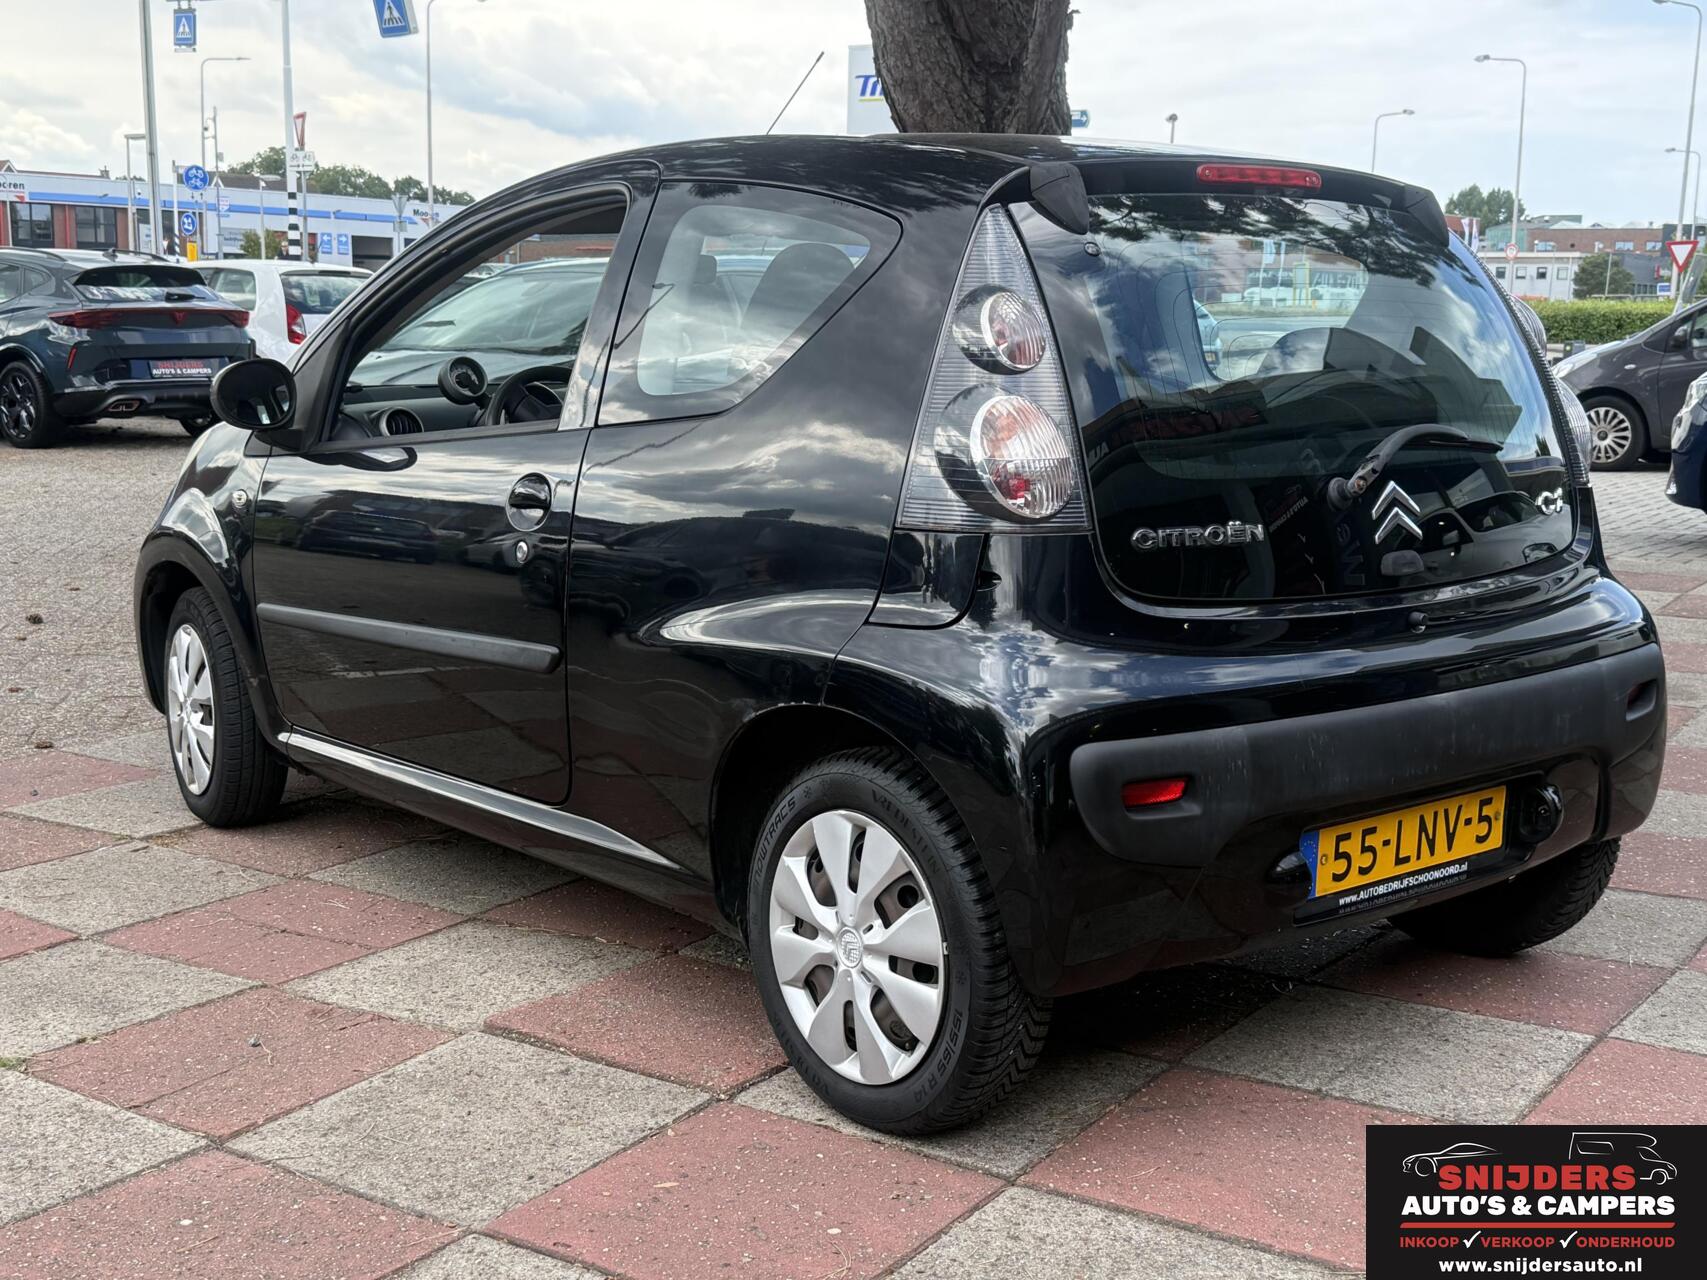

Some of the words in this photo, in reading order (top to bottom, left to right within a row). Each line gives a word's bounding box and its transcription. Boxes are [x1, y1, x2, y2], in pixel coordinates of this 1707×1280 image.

[1131, 521, 1265, 549] CITROËN
[1331, 797, 1494, 883] 55-LNV-5
[1339, 862, 1468, 906] www.AUTOBEDRIJFSCHOONOORD.nl
